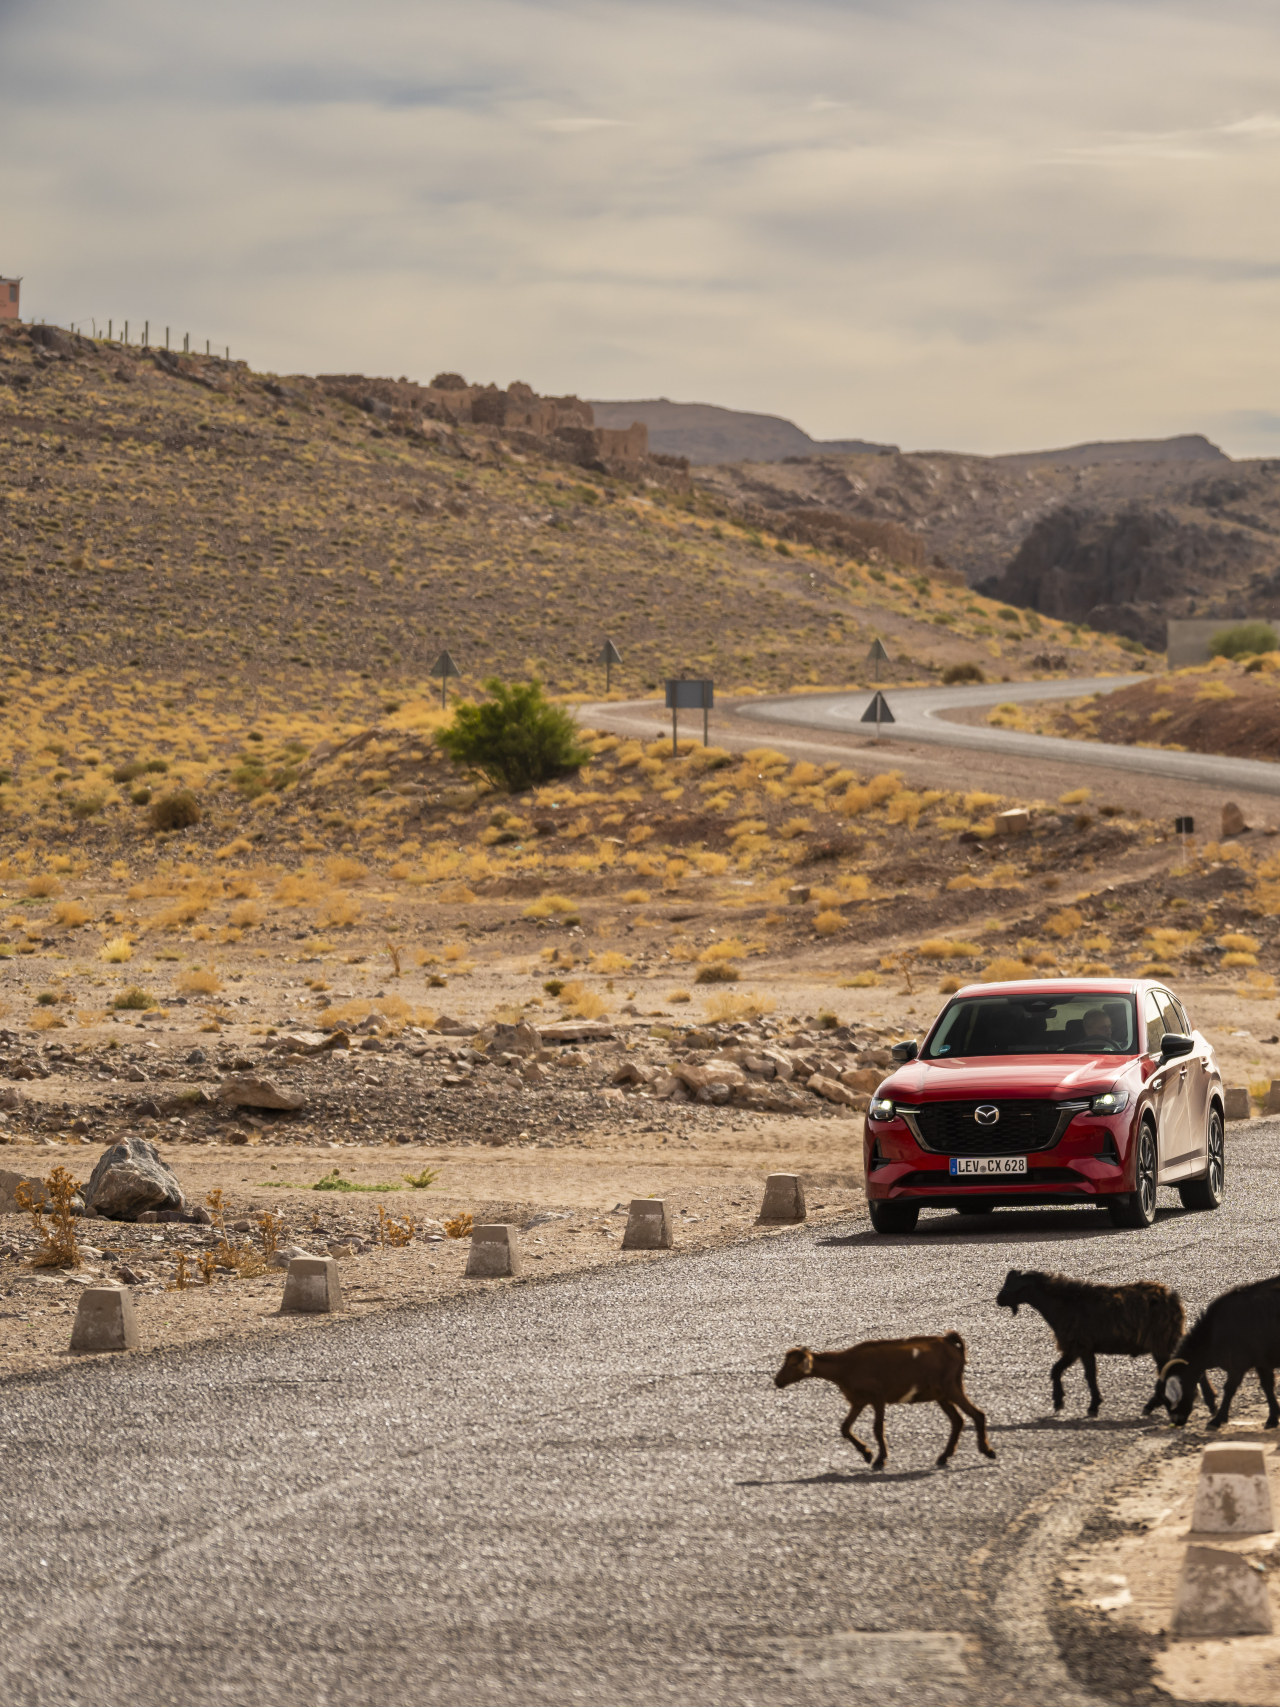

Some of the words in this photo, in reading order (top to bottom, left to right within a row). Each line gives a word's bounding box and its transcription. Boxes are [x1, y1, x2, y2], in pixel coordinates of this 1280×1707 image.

[958, 1160, 979, 1173] LEV
[987, 1160, 1001, 1172] CX
[1004, 1159, 1024, 1172] 628
